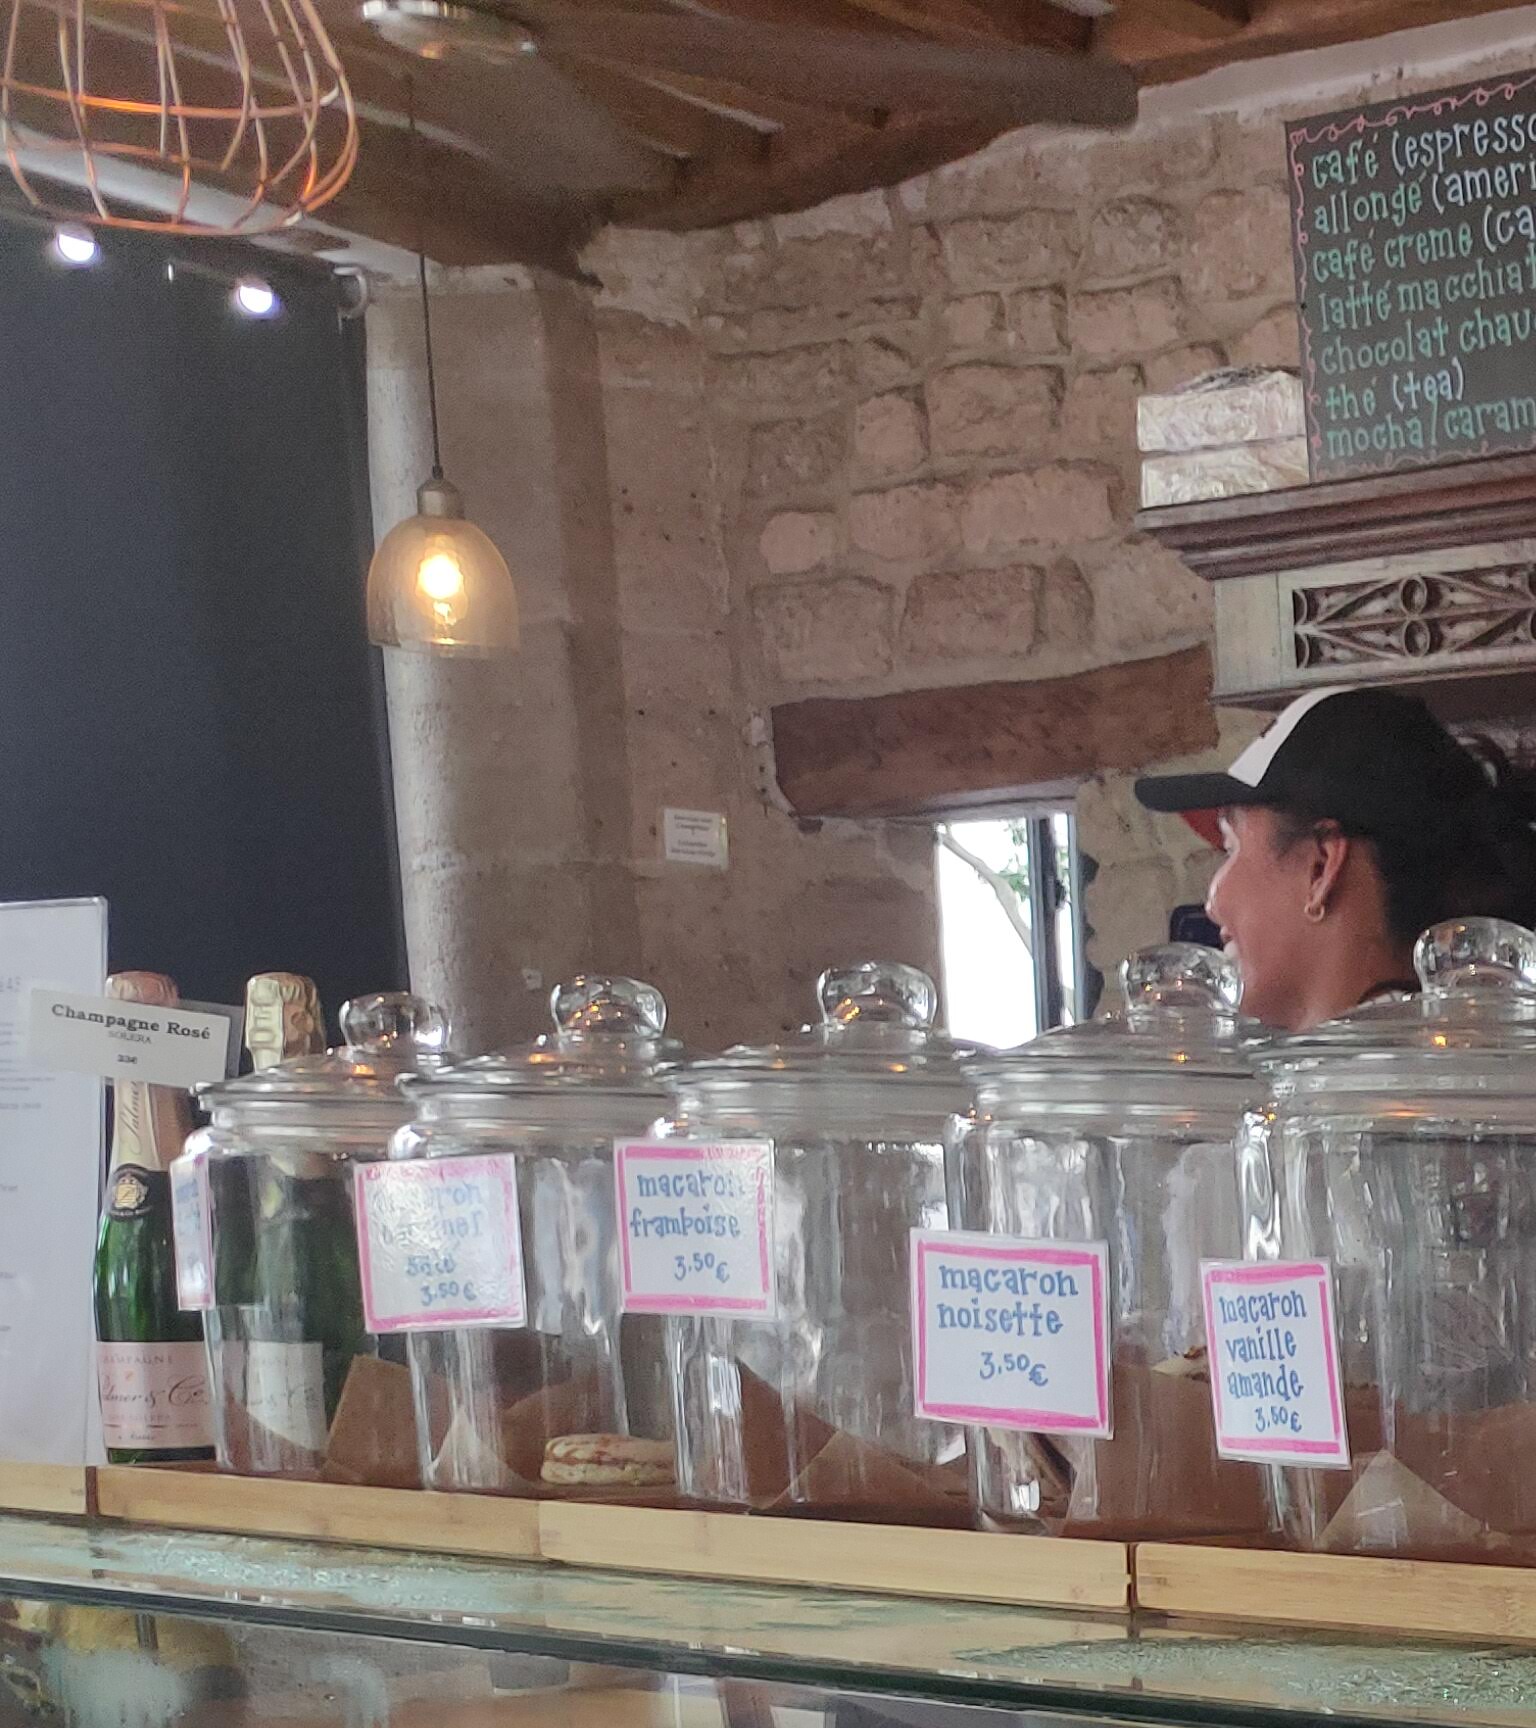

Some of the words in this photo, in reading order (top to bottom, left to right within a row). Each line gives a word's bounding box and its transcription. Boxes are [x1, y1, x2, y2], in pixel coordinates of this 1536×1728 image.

[1313, 133, 1378, 190] café
[1314, 170, 1428, 235] allongé
[1313, 228, 1376, 283] café
[1319, 280, 1391, 332] latté
[1320, 316, 1449, 376] chocolat
[1326, 376, 1378, 421] thé
[1392, 356, 1465, 413] (tea)
[52, 1003, 160, 1032] Champagne
[166, 1021, 211, 1040] Rosé
[630, 1203, 741, 1238] framboise
[674, 1252, 730, 1284] 3.50€
[939, 1264, 1079, 1298] macaron
[936, 1297, 1064, 1336] noisette
[1219, 1289, 1307, 1324] macaron
[1225, 1326, 1298, 1363] vanille
[980, 1351, 1049, 1387] 3.50€
[1227, 1363, 1304, 1401] amande
